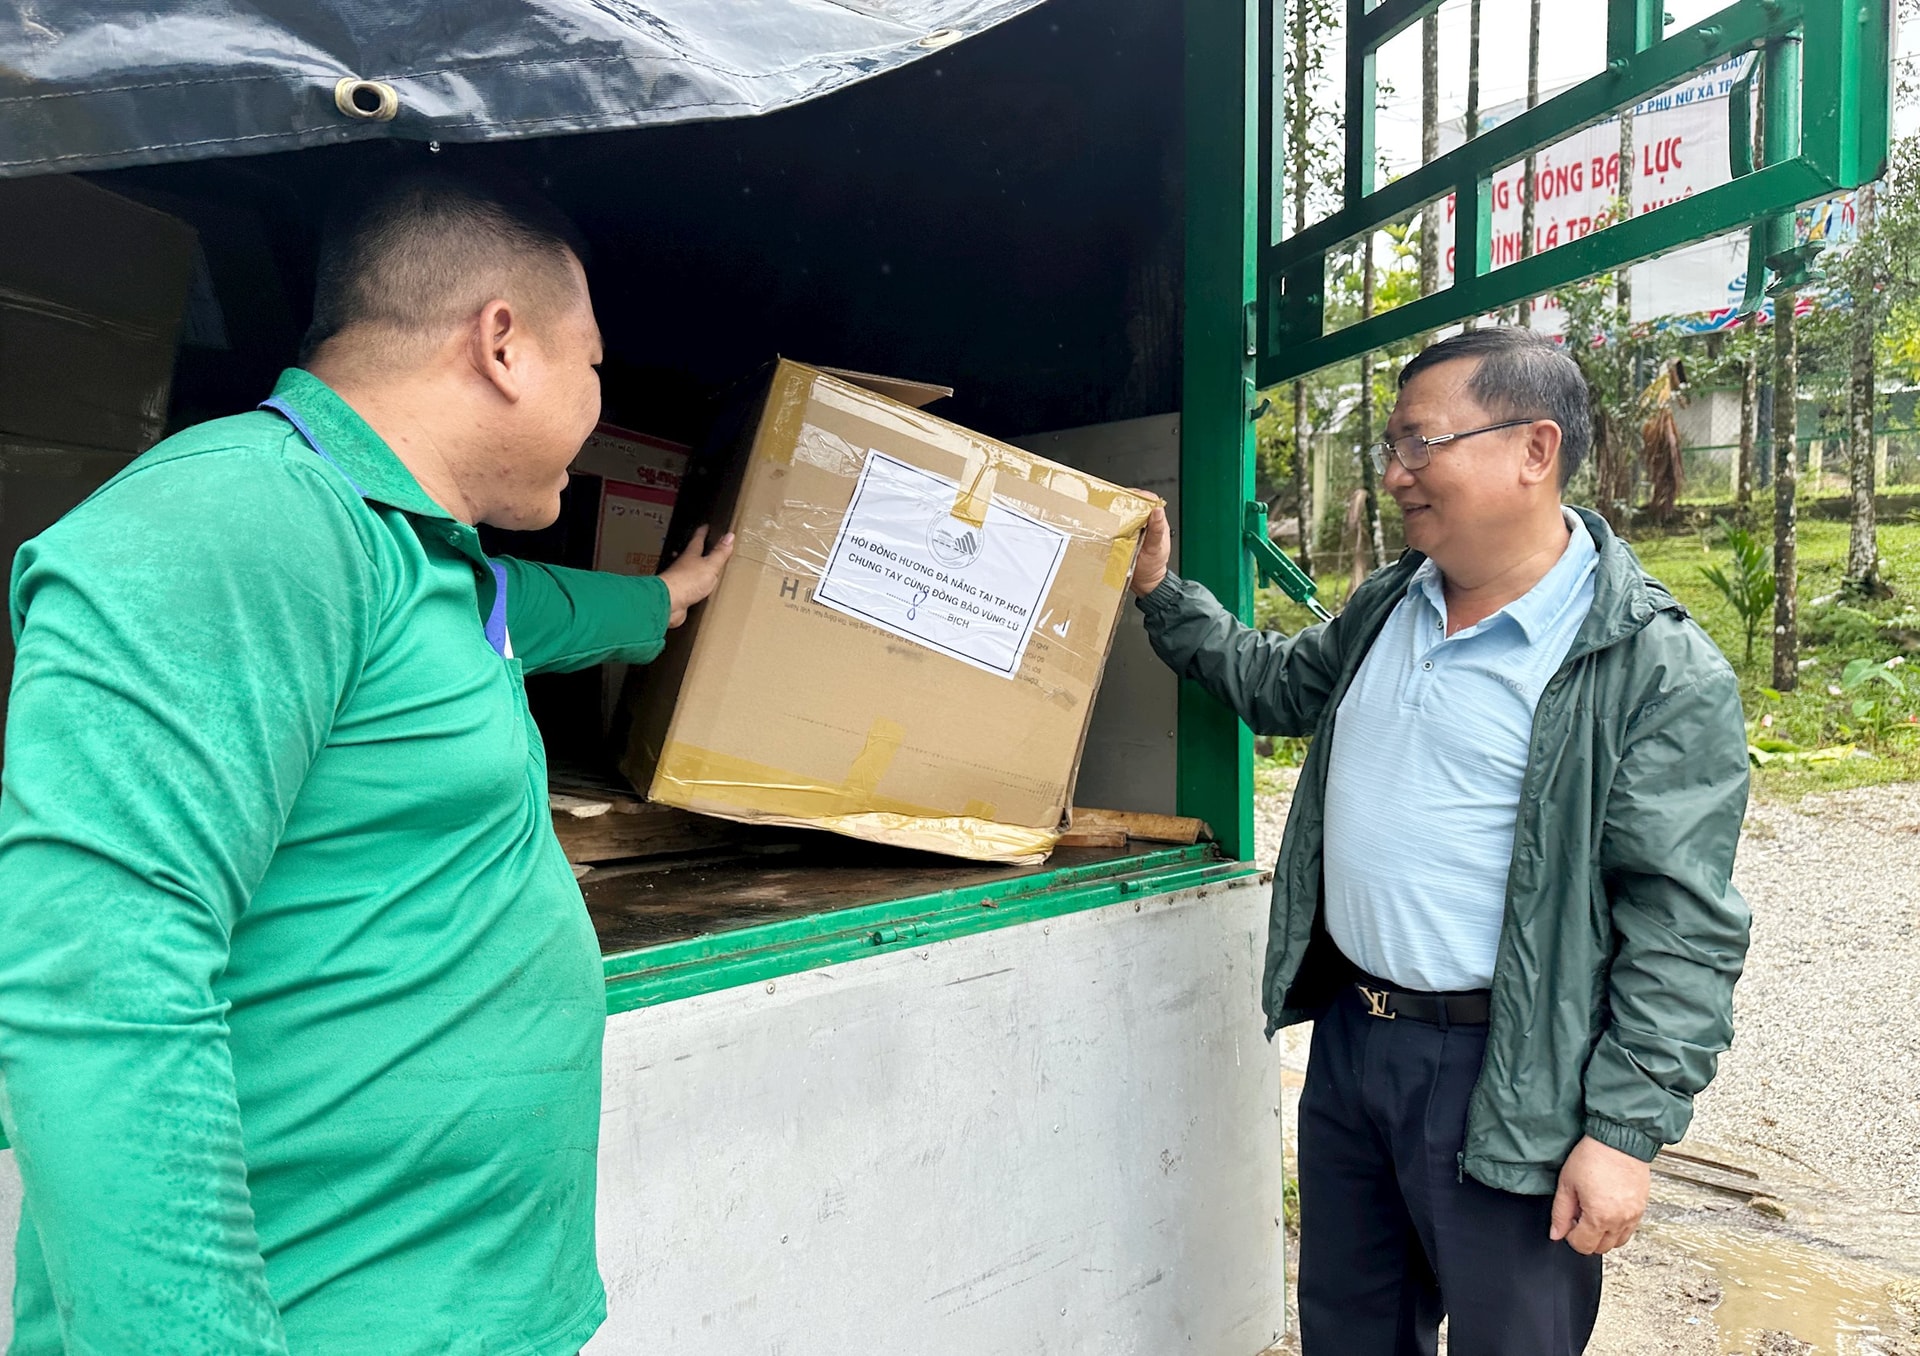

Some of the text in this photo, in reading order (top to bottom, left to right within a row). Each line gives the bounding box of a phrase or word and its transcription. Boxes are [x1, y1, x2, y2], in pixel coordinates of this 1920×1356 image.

[1647, 95, 1671, 111] PHỤ
[1591, 152, 1636, 195] BẠ
[1643, 136, 1682, 184] LỰC
[848, 553, 882, 573] CHUNG
[885, 567, 903, 582] TAY
[903, 576, 930, 594] CÙNG
[931, 588, 959, 606] ĐỒNG
[960, 600, 980, 615] BÀO
[850, 535, 869, 549] HỘI
[869, 543, 898, 562] ĐỒNG
[898, 555, 934, 577] HƯƠNG
[935, 572, 949, 584] ĐÀ
[979, 589, 993, 603] TẠI
[994, 596, 1027, 617] TP.HCM
[947, 613, 970, 628] BỊCH
